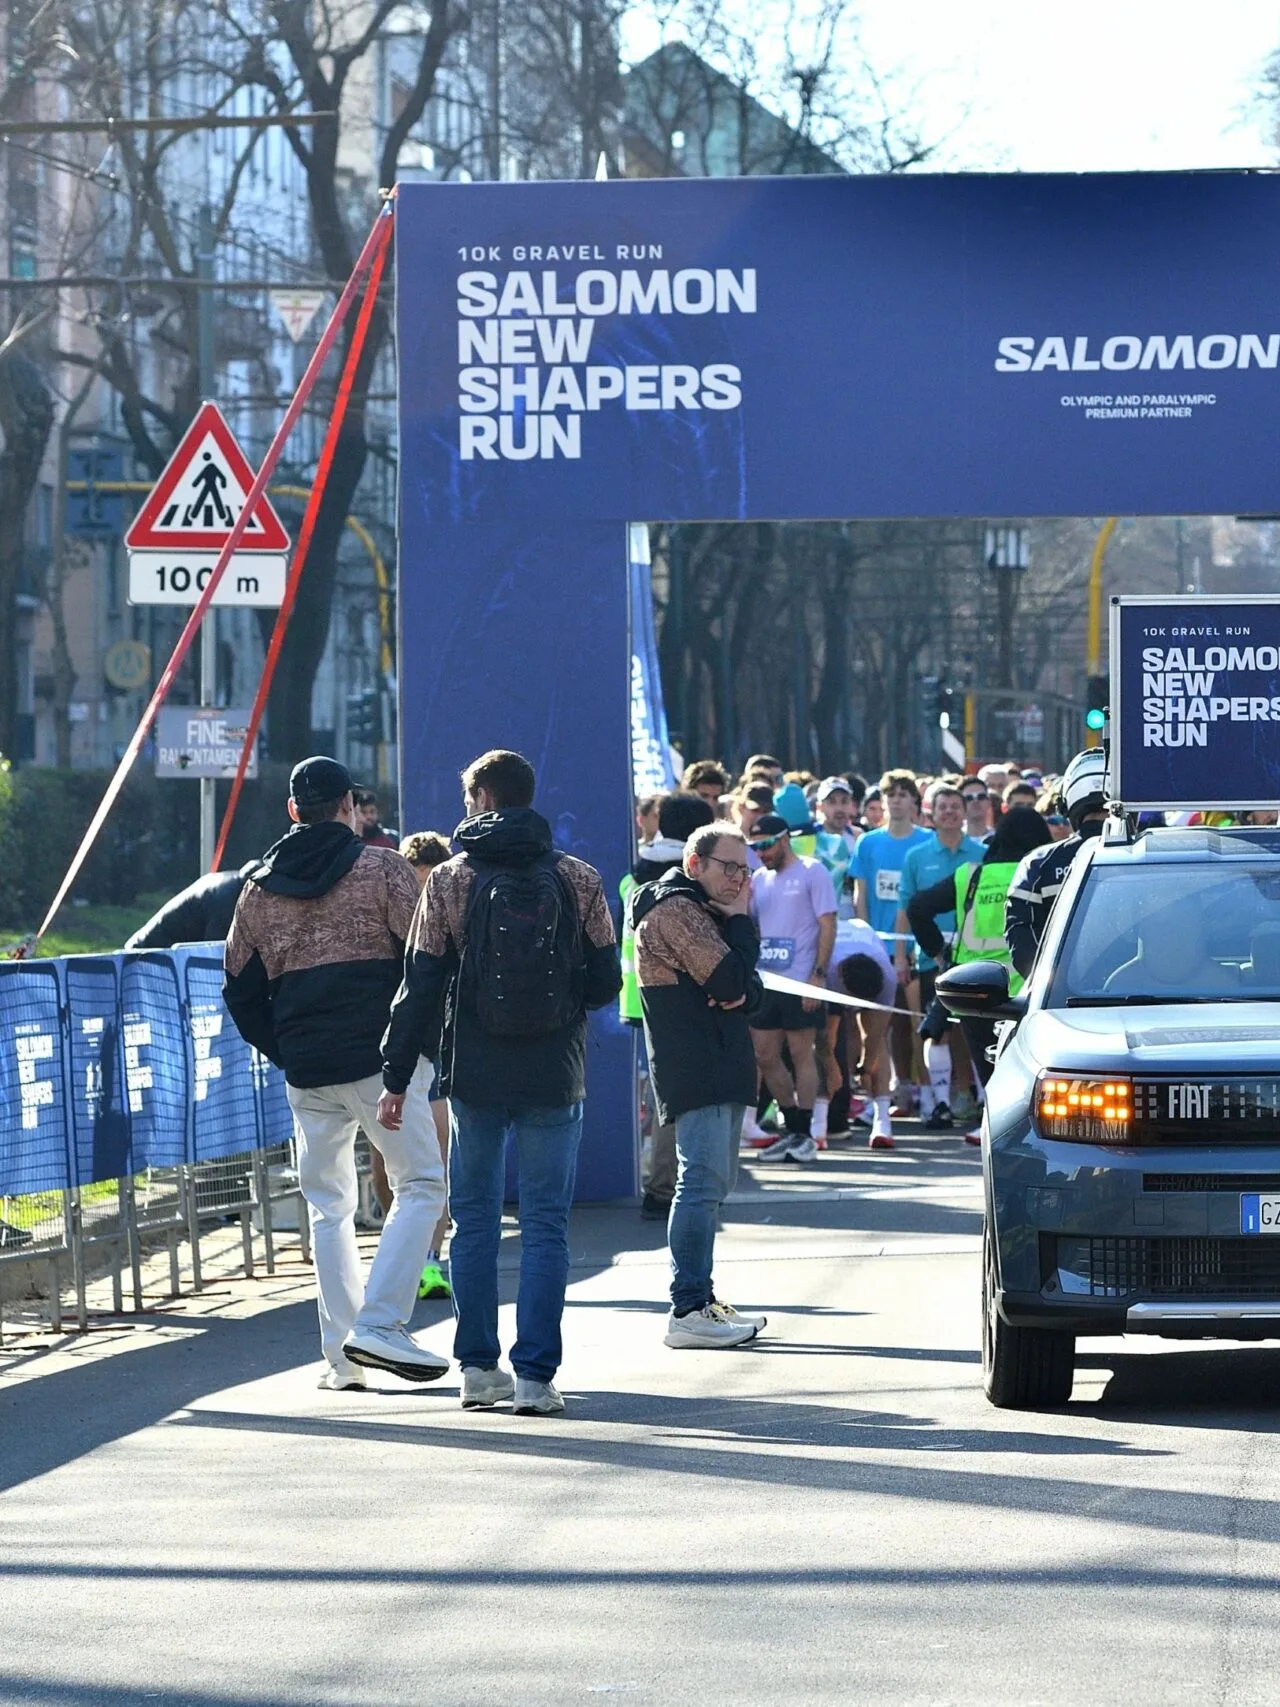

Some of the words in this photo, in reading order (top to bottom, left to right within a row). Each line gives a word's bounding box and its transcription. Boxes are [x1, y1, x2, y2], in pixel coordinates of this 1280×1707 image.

[458, 245, 501, 262] 10K
[513, 245, 606, 261] GRAVEL
[616, 244, 663, 260] RUN
[457, 268, 757, 318] SALOMON
[458, 318, 595, 364] NEW
[994, 334, 1280, 372] SALOMON
[458, 363, 742, 413] SHAPERS
[1061, 395, 1112, 406] OLYMPIC
[1115, 395, 1141, 406] AND
[1143, 393, 1216, 405] PARALYMPIC
[1086, 407, 1138, 419] PREMIUM
[1141, 406, 1192, 418] PARTNER
[460, 414, 581, 461] RUN
[237, 576, 259, 593] m
[1143, 628, 1166, 636] 10K
[1171, 627, 1221, 636] GRAVEL
[1226, 627, 1251, 635] RUN
[1143, 672, 1215, 697] NEW
[187, 720, 228, 745] FINE
[1143, 723, 1208, 747] RUN
[1168, 1084, 1212, 1118] FIAT
